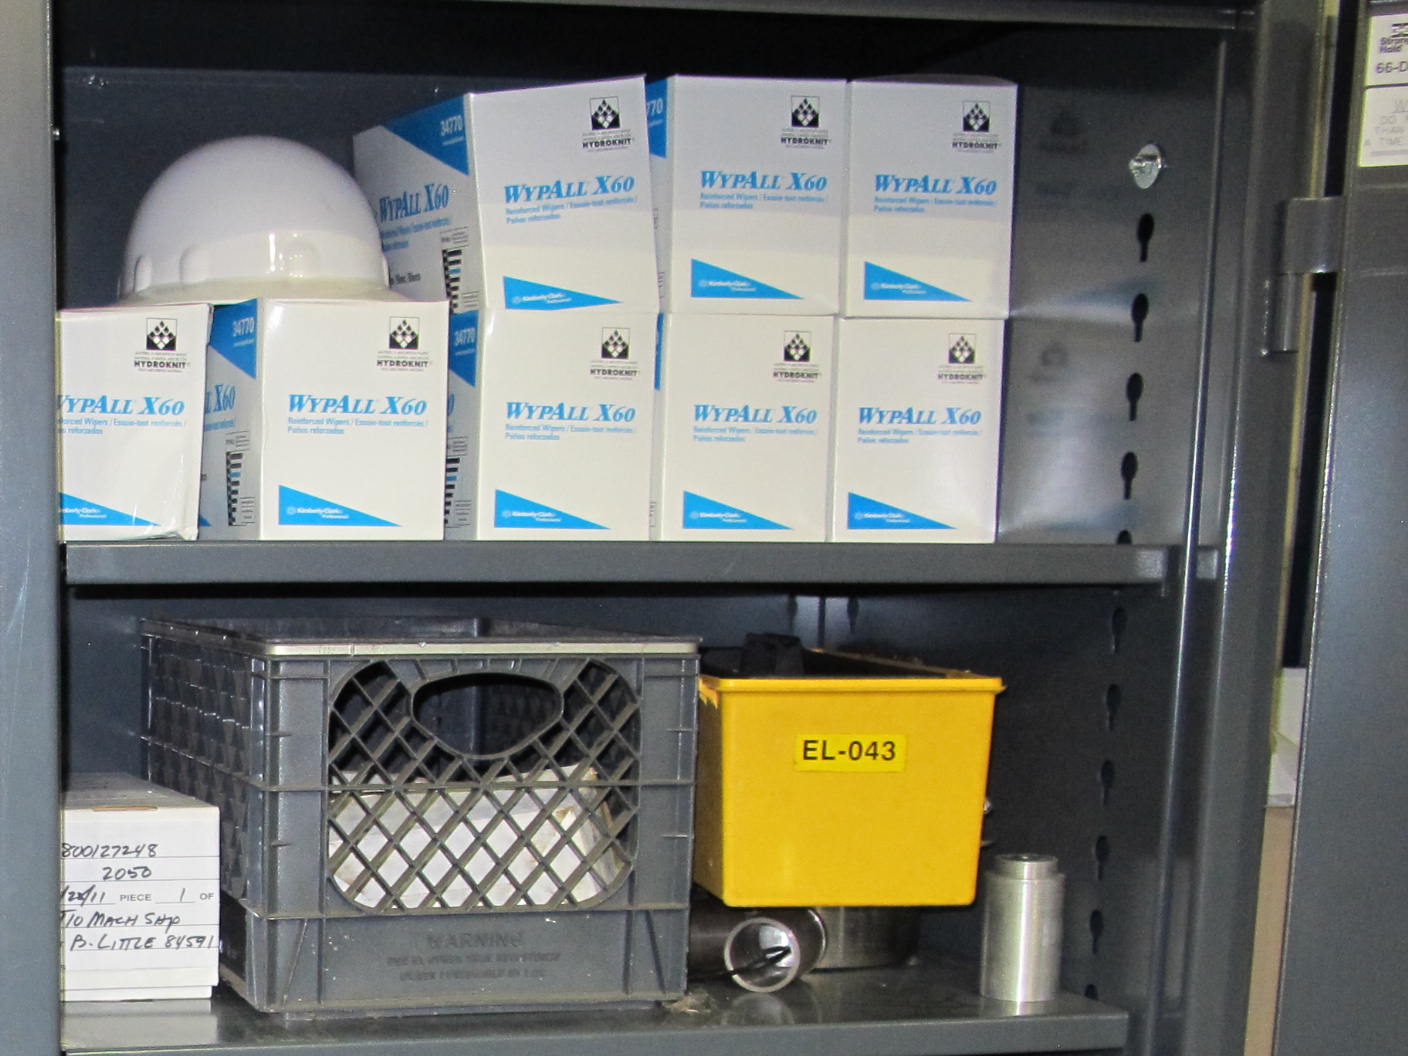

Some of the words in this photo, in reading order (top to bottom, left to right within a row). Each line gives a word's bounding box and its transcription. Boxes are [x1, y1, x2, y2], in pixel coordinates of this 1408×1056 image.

[583, 138, 632, 149] HYDROKNIT
[781, 137, 829, 145] HYDROKNIT
[952, 142, 999, 150] HYDROKNIT
[592, 176, 635, 196] X60
[786, 172, 828, 191] X60
[955, 177, 997, 195] X60
[424, 184, 449, 211] X60
[134, 360, 187, 369] HYDROKNIT
[377, 360, 429, 368] HYDROKNIT
[590, 369, 637, 377] HYDROKNIT
[938, 373, 983, 381] HYDROKNIT
[139, 397, 185, 415] X60
[382, 396, 428, 415] X60
[593, 404, 636, 422] X60
[778, 405, 817, 424] X60
[942, 407, 982, 425] X60
[803, 740, 896, 761] EL-043
[62, 843, 159, 859] 800127248
[102, 866, 152, 881] 2050
[120, 894, 152, 902] PIECE
[179, 888, 186, 902] 1
[199, 893, 214, 901] OF
